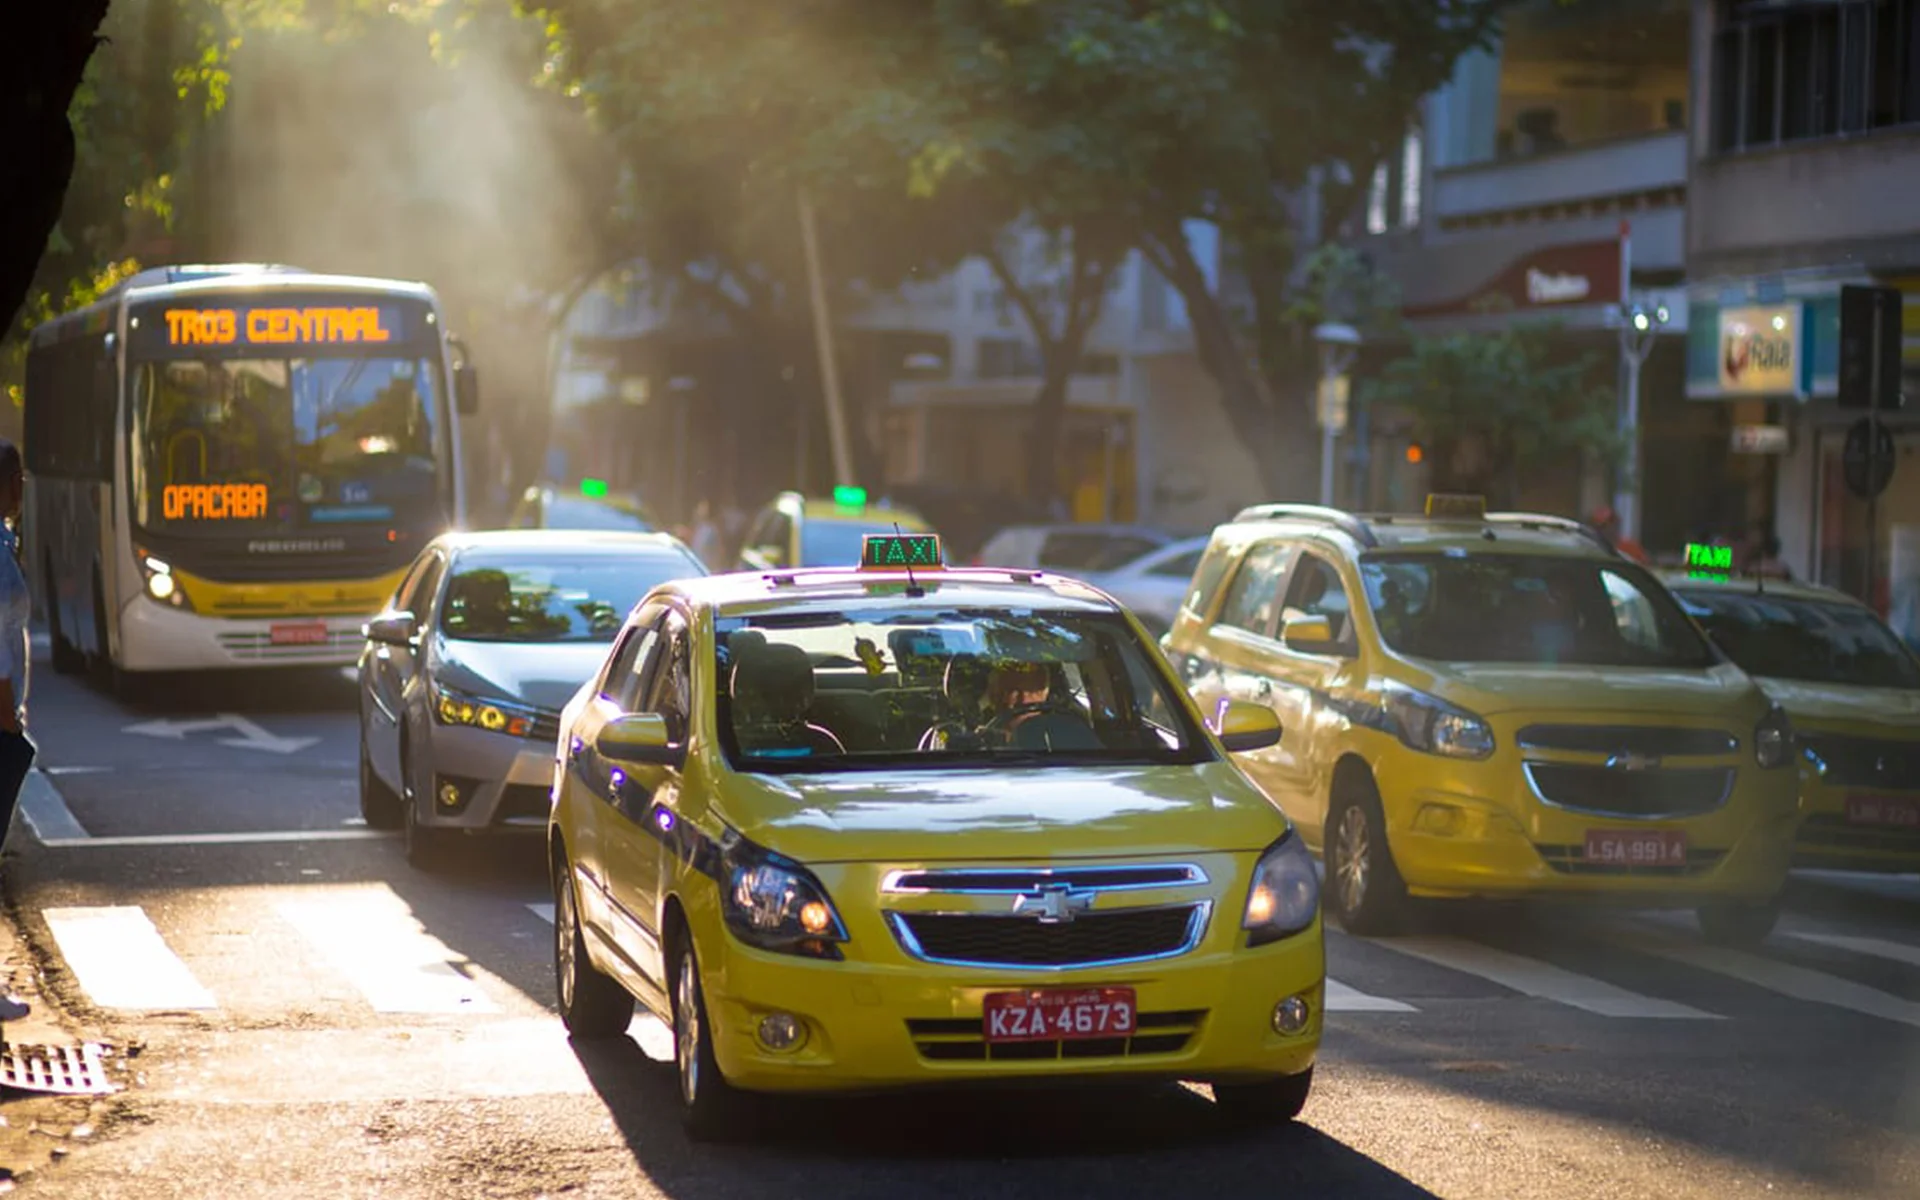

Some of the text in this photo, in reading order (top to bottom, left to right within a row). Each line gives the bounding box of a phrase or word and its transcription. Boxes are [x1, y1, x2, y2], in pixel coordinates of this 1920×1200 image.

[247, 307, 389, 343] CENTRAL
[163, 483, 268, 519] OPACABA
[867, 538, 938, 564] TAXI
[1690, 543, 1732, 568] TAXI
